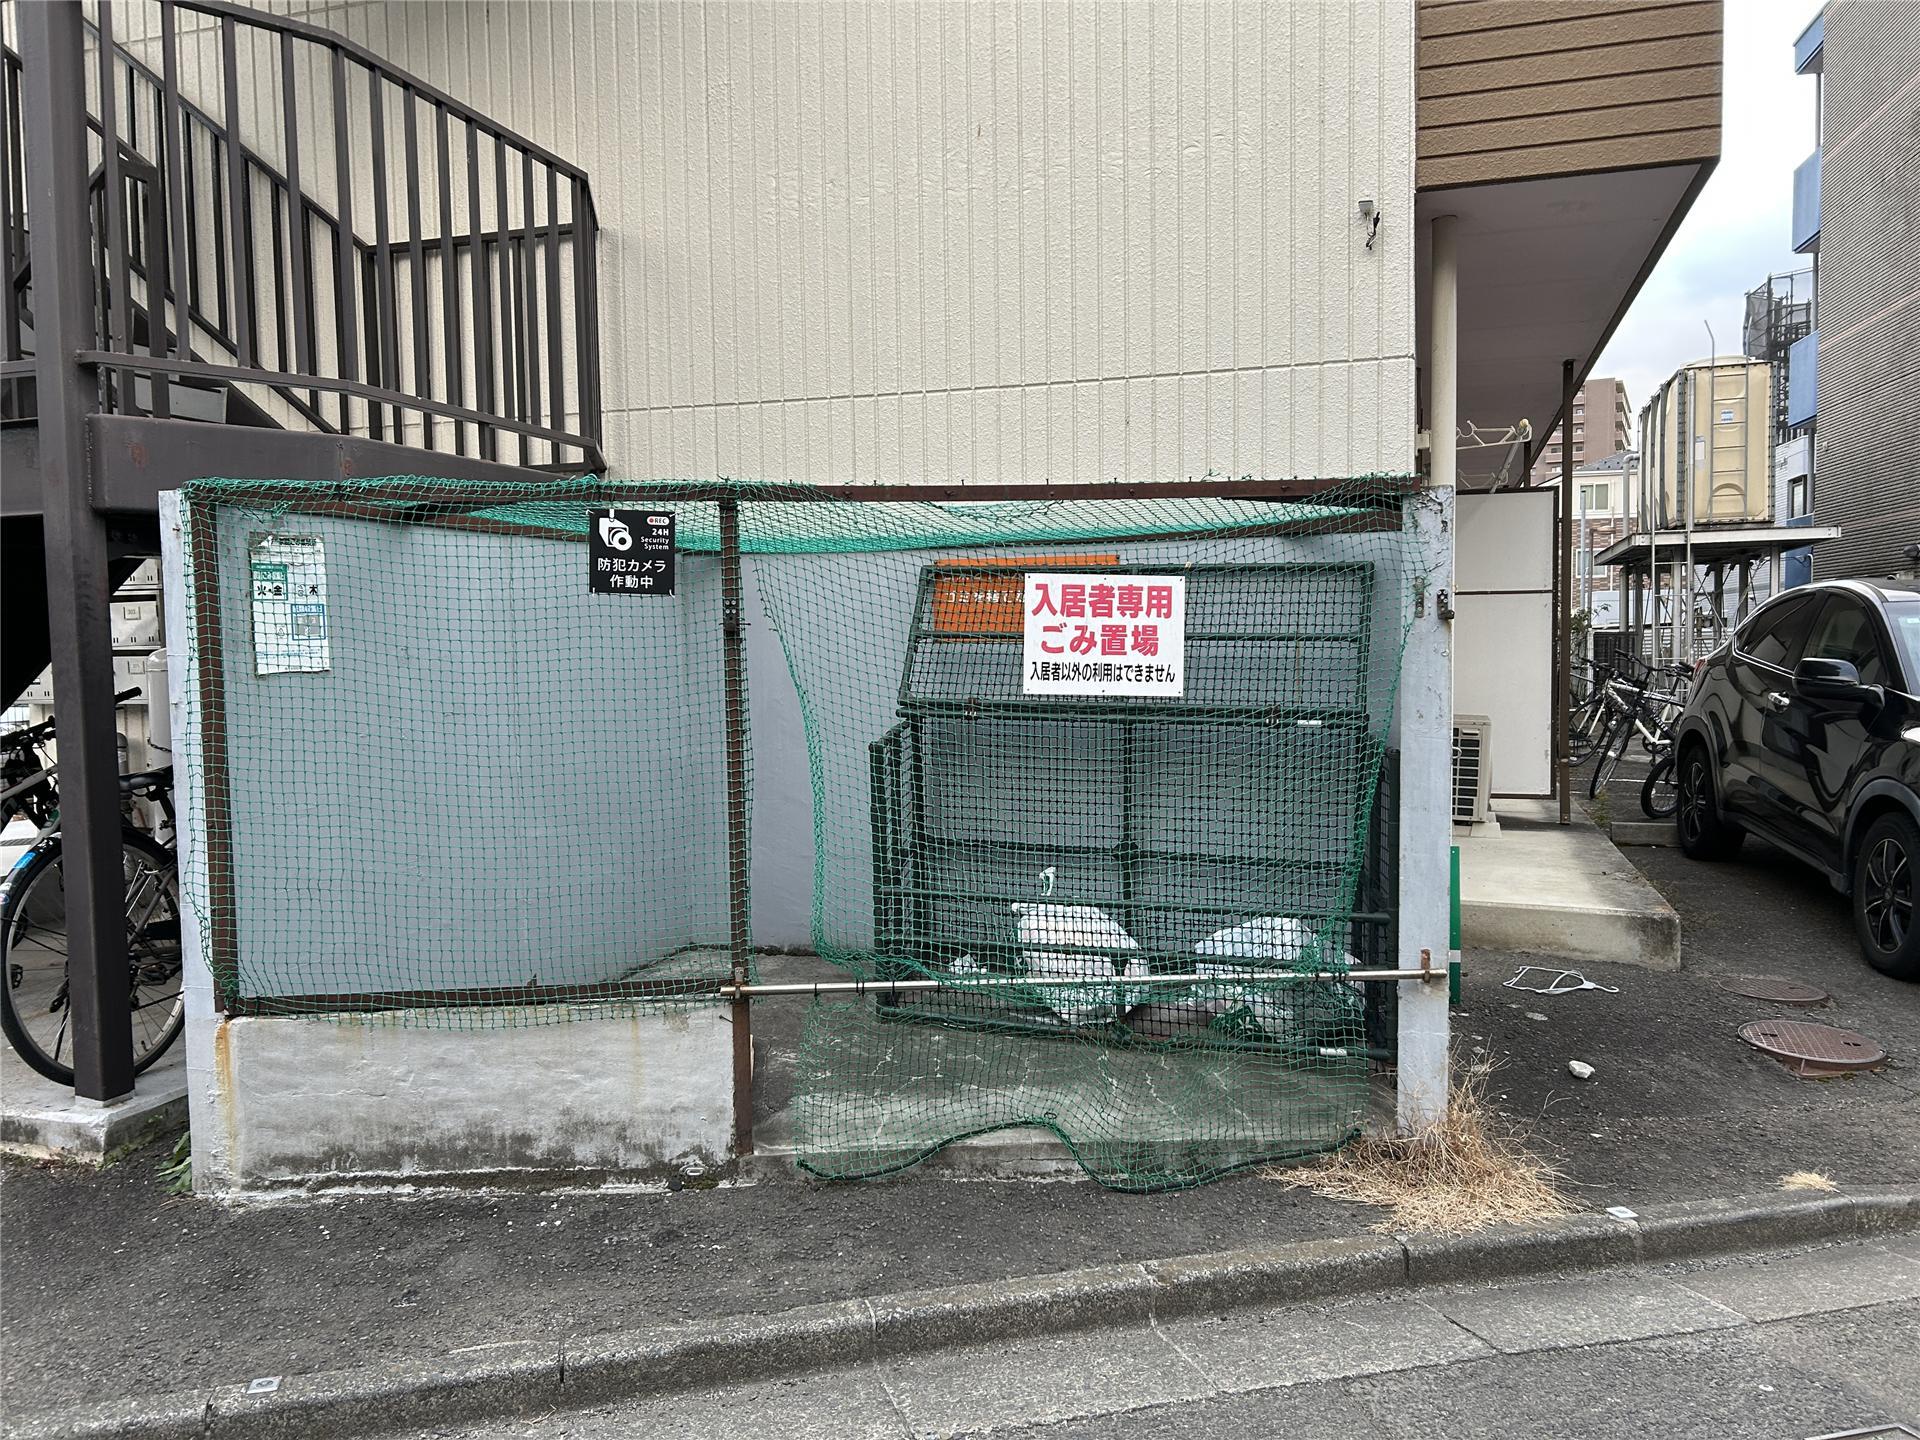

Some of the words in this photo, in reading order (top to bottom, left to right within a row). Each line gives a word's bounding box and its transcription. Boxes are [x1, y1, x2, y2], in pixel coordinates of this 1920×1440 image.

[652, 528, 669, 536] 24H
[640, 536, 669, 544] Security
[597, 557, 666, 572] 防犯カメラ
[609, 574, 653, 589] 作動中
[309, 584, 318, 596] 木
[1031, 583, 1173, 619] 入居者専用
[1041, 622, 1159, 657] ごみ置場
[1030, 661, 1176, 683] 入居者以外の利用はできません
